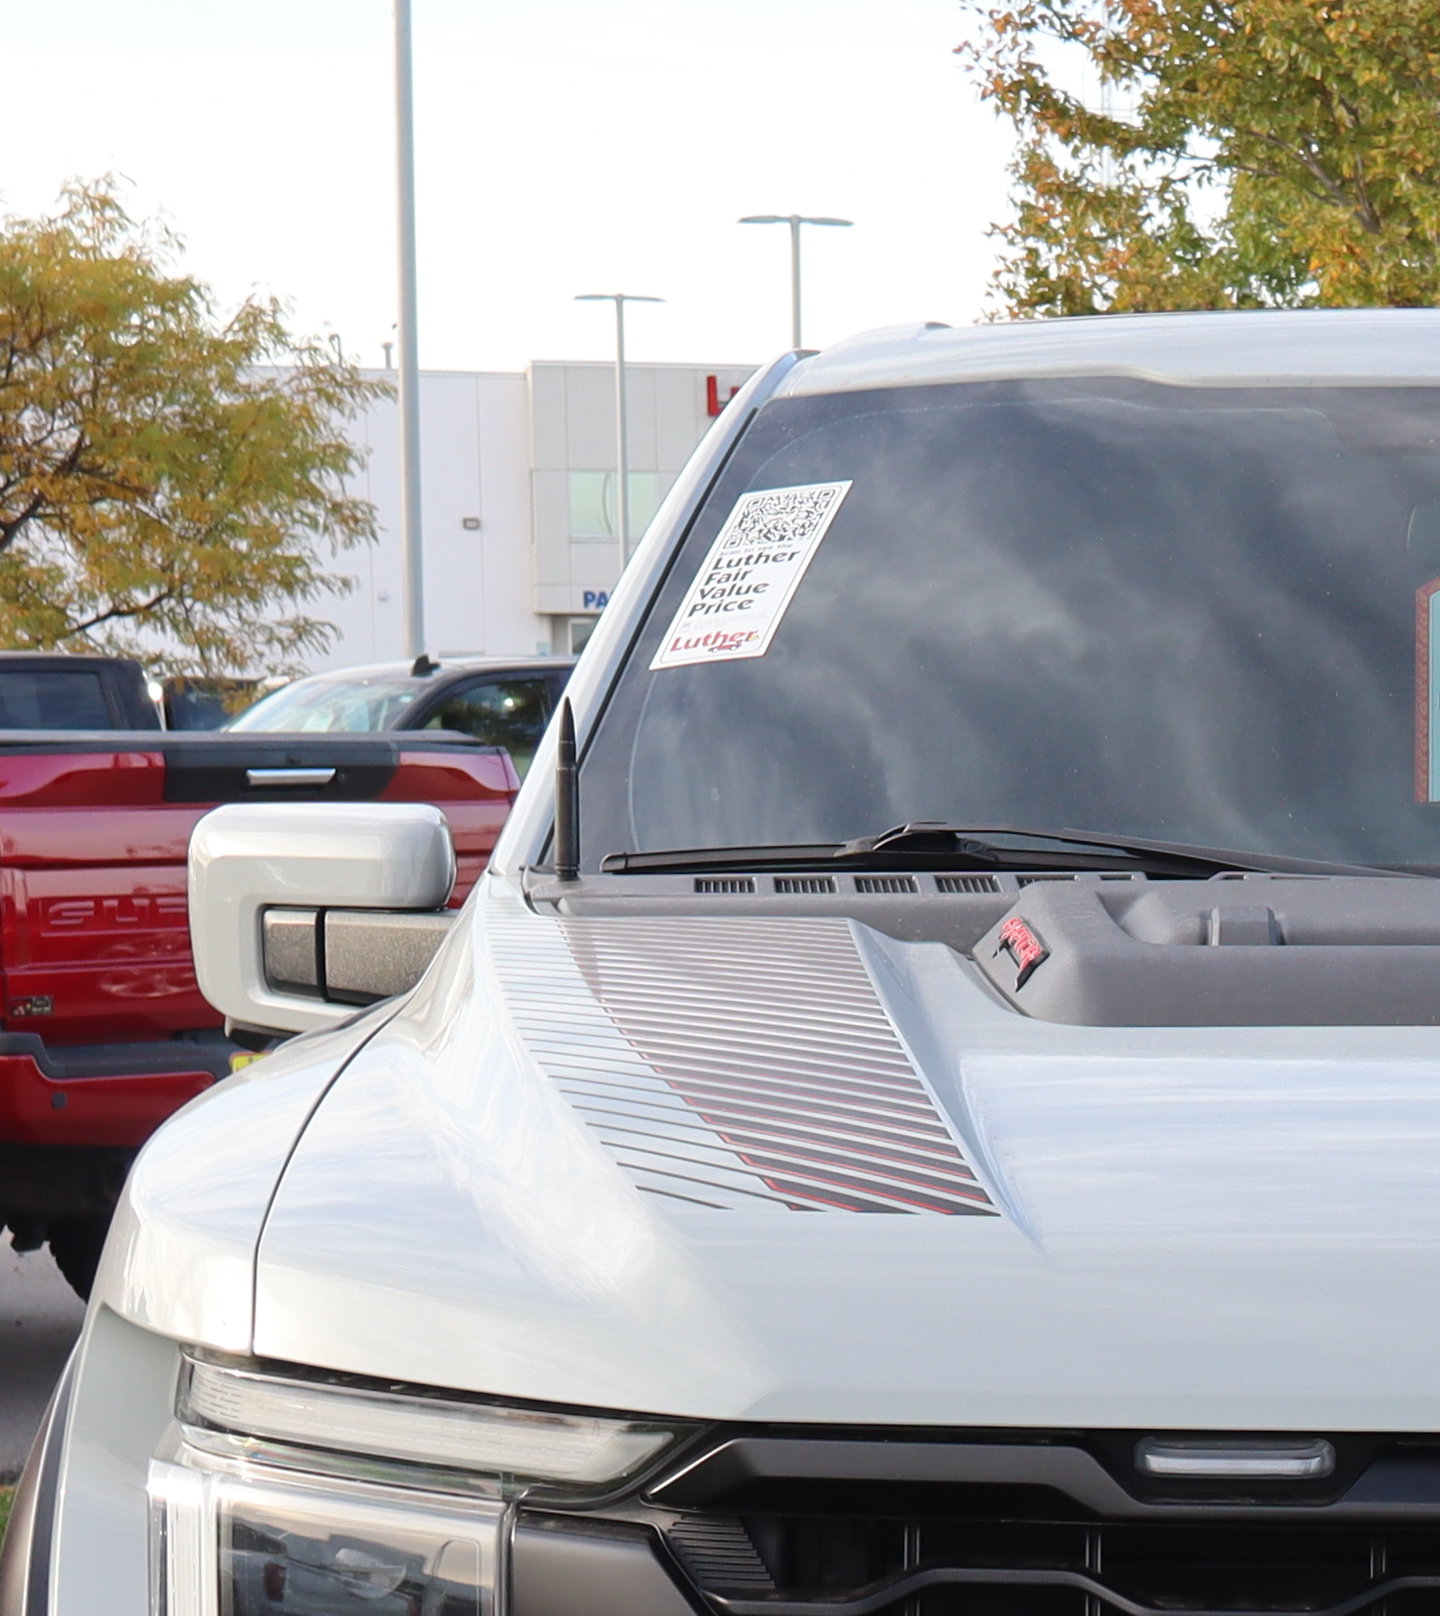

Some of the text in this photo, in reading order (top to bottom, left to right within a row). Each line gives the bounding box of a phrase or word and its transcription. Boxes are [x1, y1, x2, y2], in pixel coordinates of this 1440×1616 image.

[712, 550, 801, 571] Luther
[704, 569, 752, 586] Fair
[699, 582, 770, 600] Value
[687, 599, 754, 617] Price
[670, 630, 759, 651] Luther
